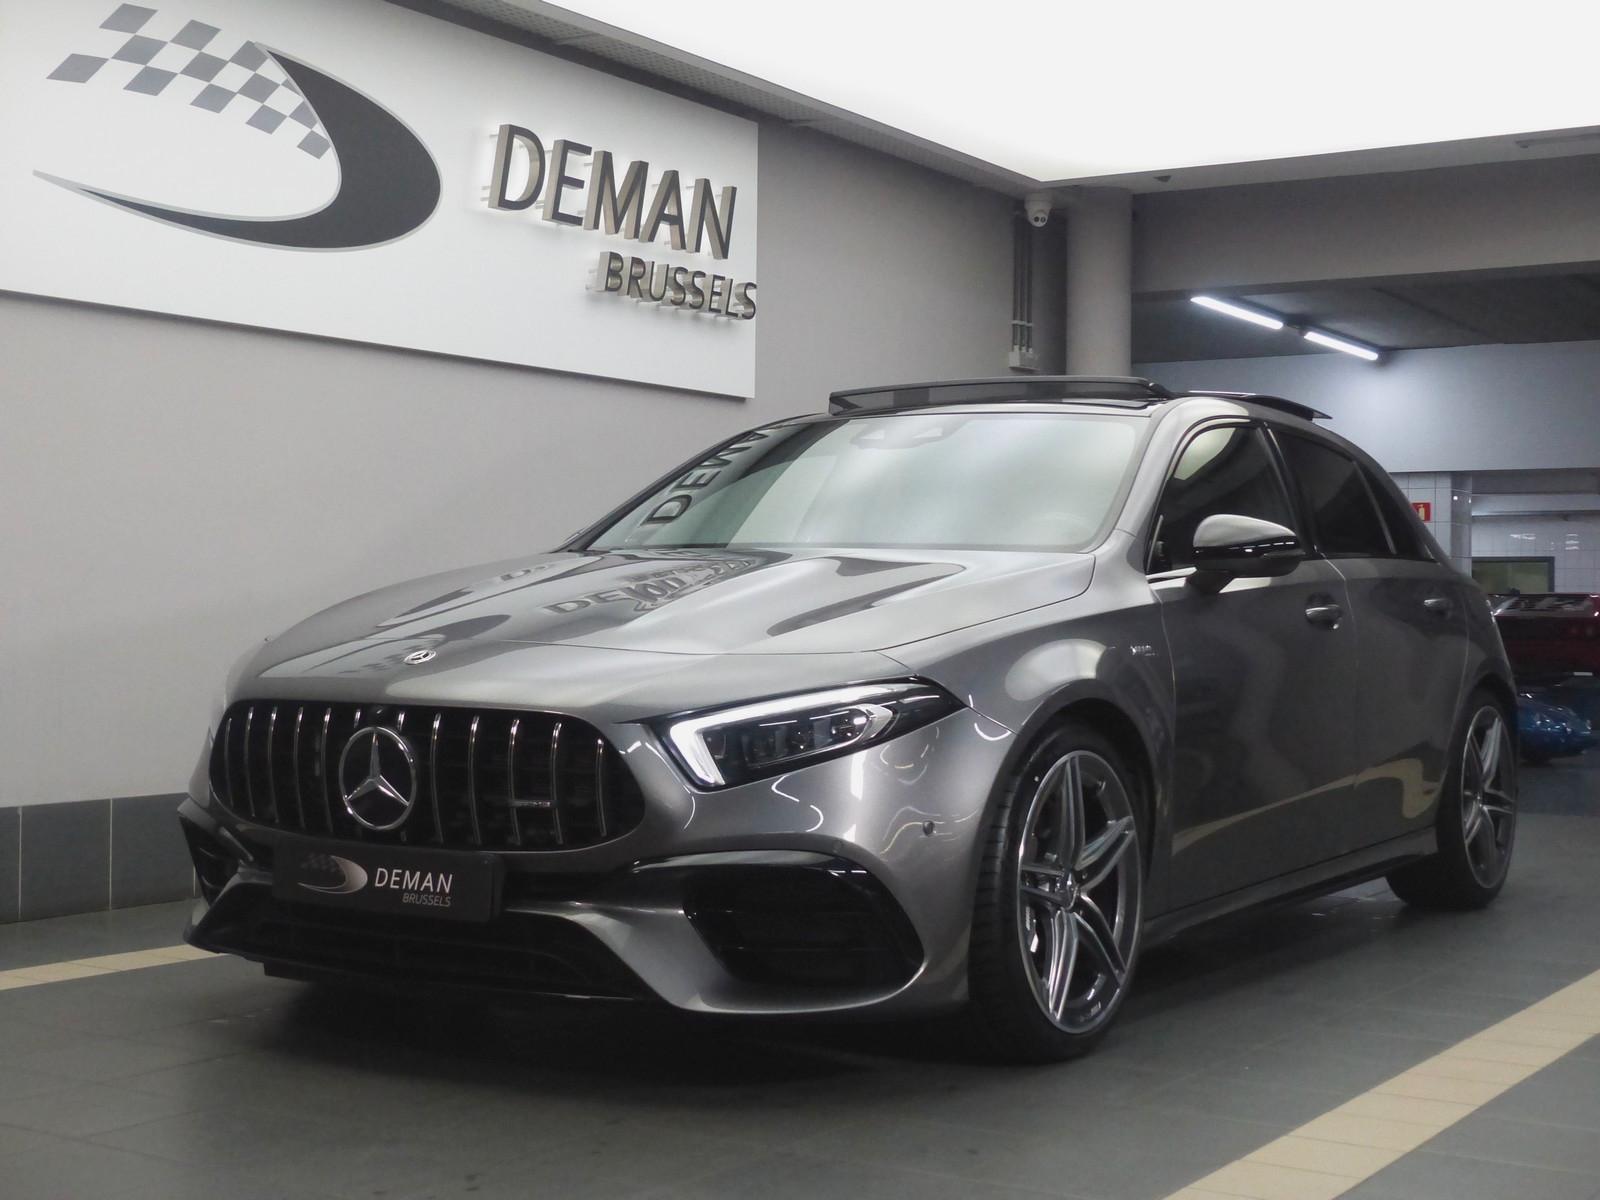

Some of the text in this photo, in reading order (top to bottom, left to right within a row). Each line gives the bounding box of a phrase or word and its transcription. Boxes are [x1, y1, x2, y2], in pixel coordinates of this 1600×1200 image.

[487, 123, 737, 260] DEMAN
[602, 251, 757, 319] BRUSSELS
[375, 867, 453, 893] DEMAN
[402, 893, 451, 907] BRUSSELS
